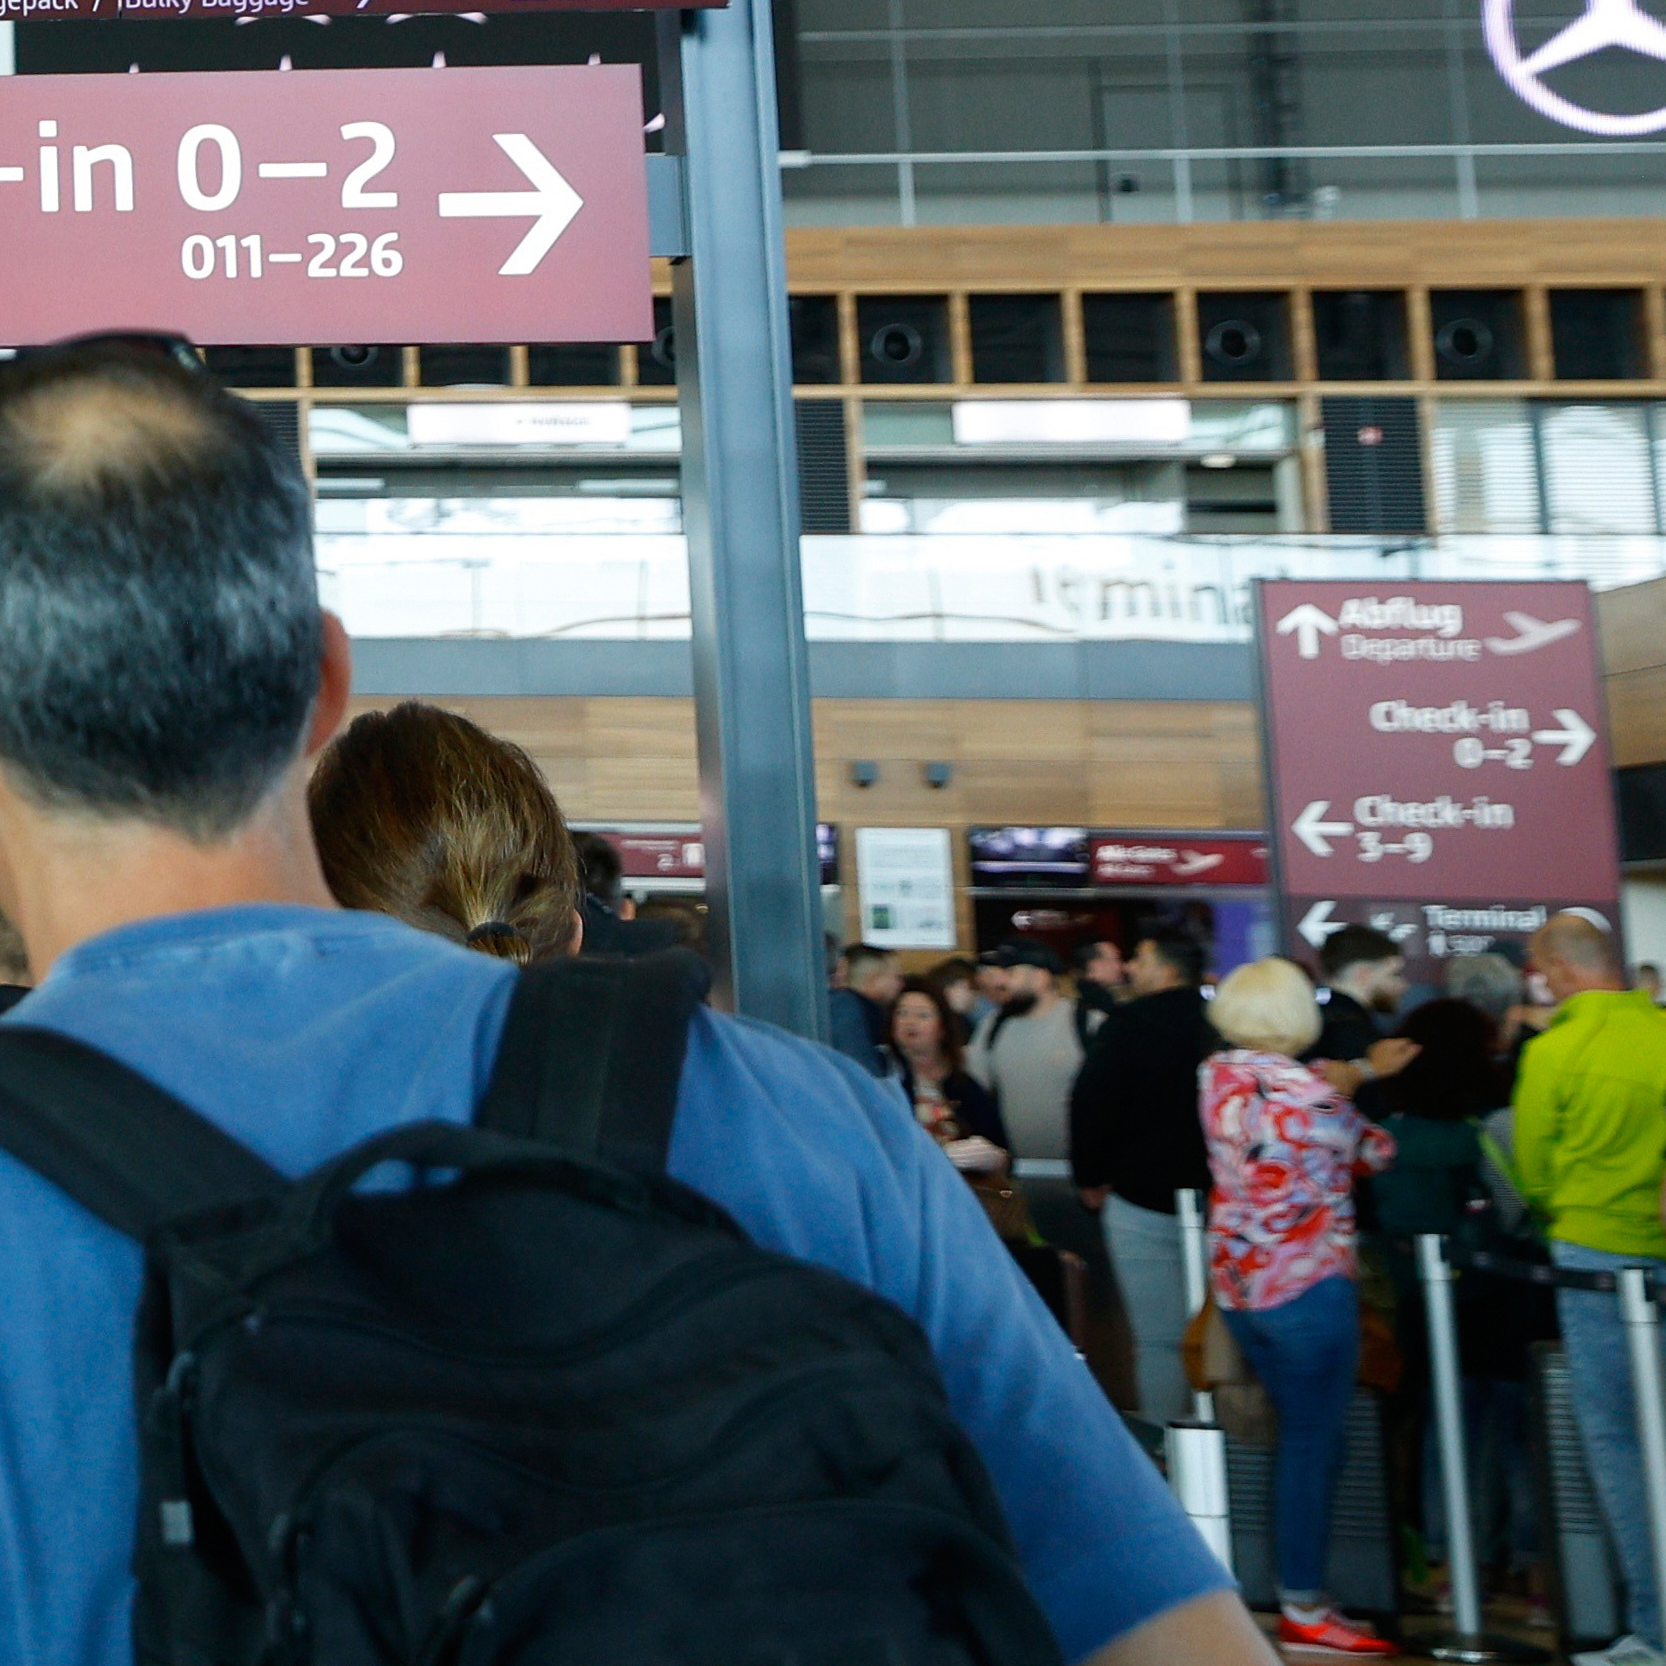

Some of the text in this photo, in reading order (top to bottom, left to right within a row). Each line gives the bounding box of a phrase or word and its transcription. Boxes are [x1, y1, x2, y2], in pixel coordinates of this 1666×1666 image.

[1368, 700, 1531, 733] Check-in
[1353, 795, 1514, 828] Check-in
[1423, 905, 1547, 931] Terminal
